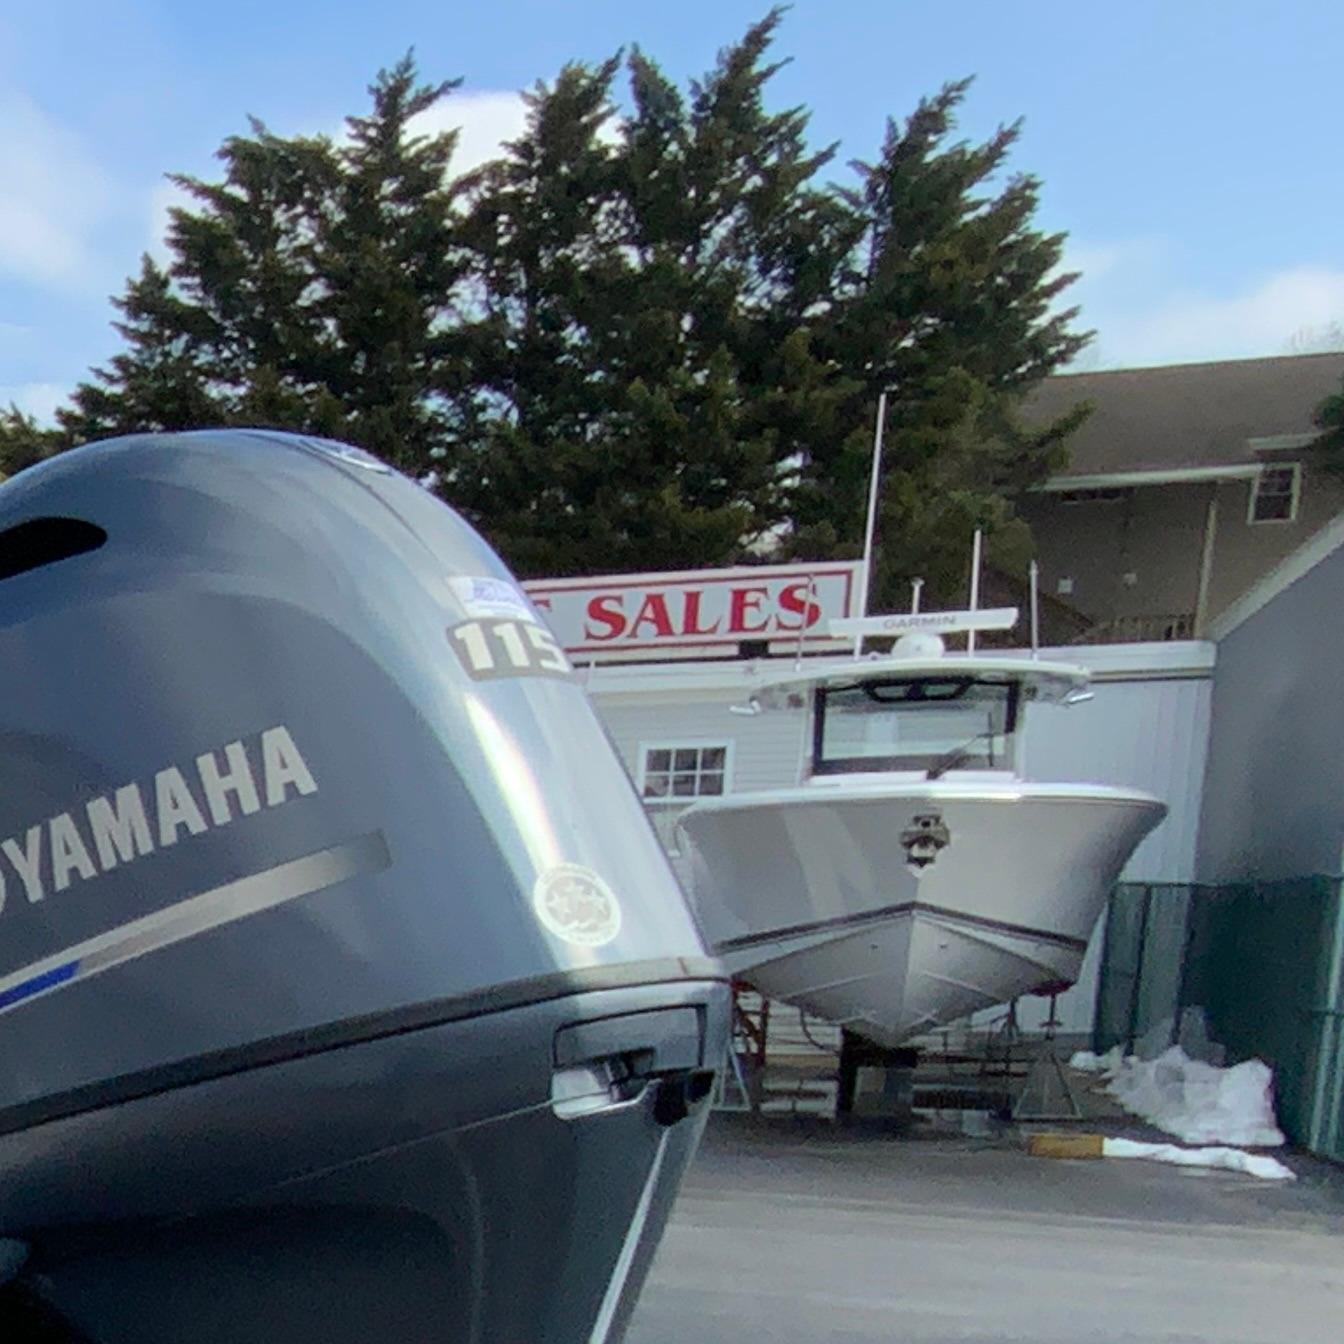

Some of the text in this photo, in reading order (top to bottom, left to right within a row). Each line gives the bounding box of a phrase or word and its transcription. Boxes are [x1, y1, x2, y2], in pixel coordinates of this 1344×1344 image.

[584, 584, 821, 641] SALES
[883, 615, 957, 630] GARMIN
[454, 621, 572, 673] 115
[1, 725, 318, 903] YAMAHA
